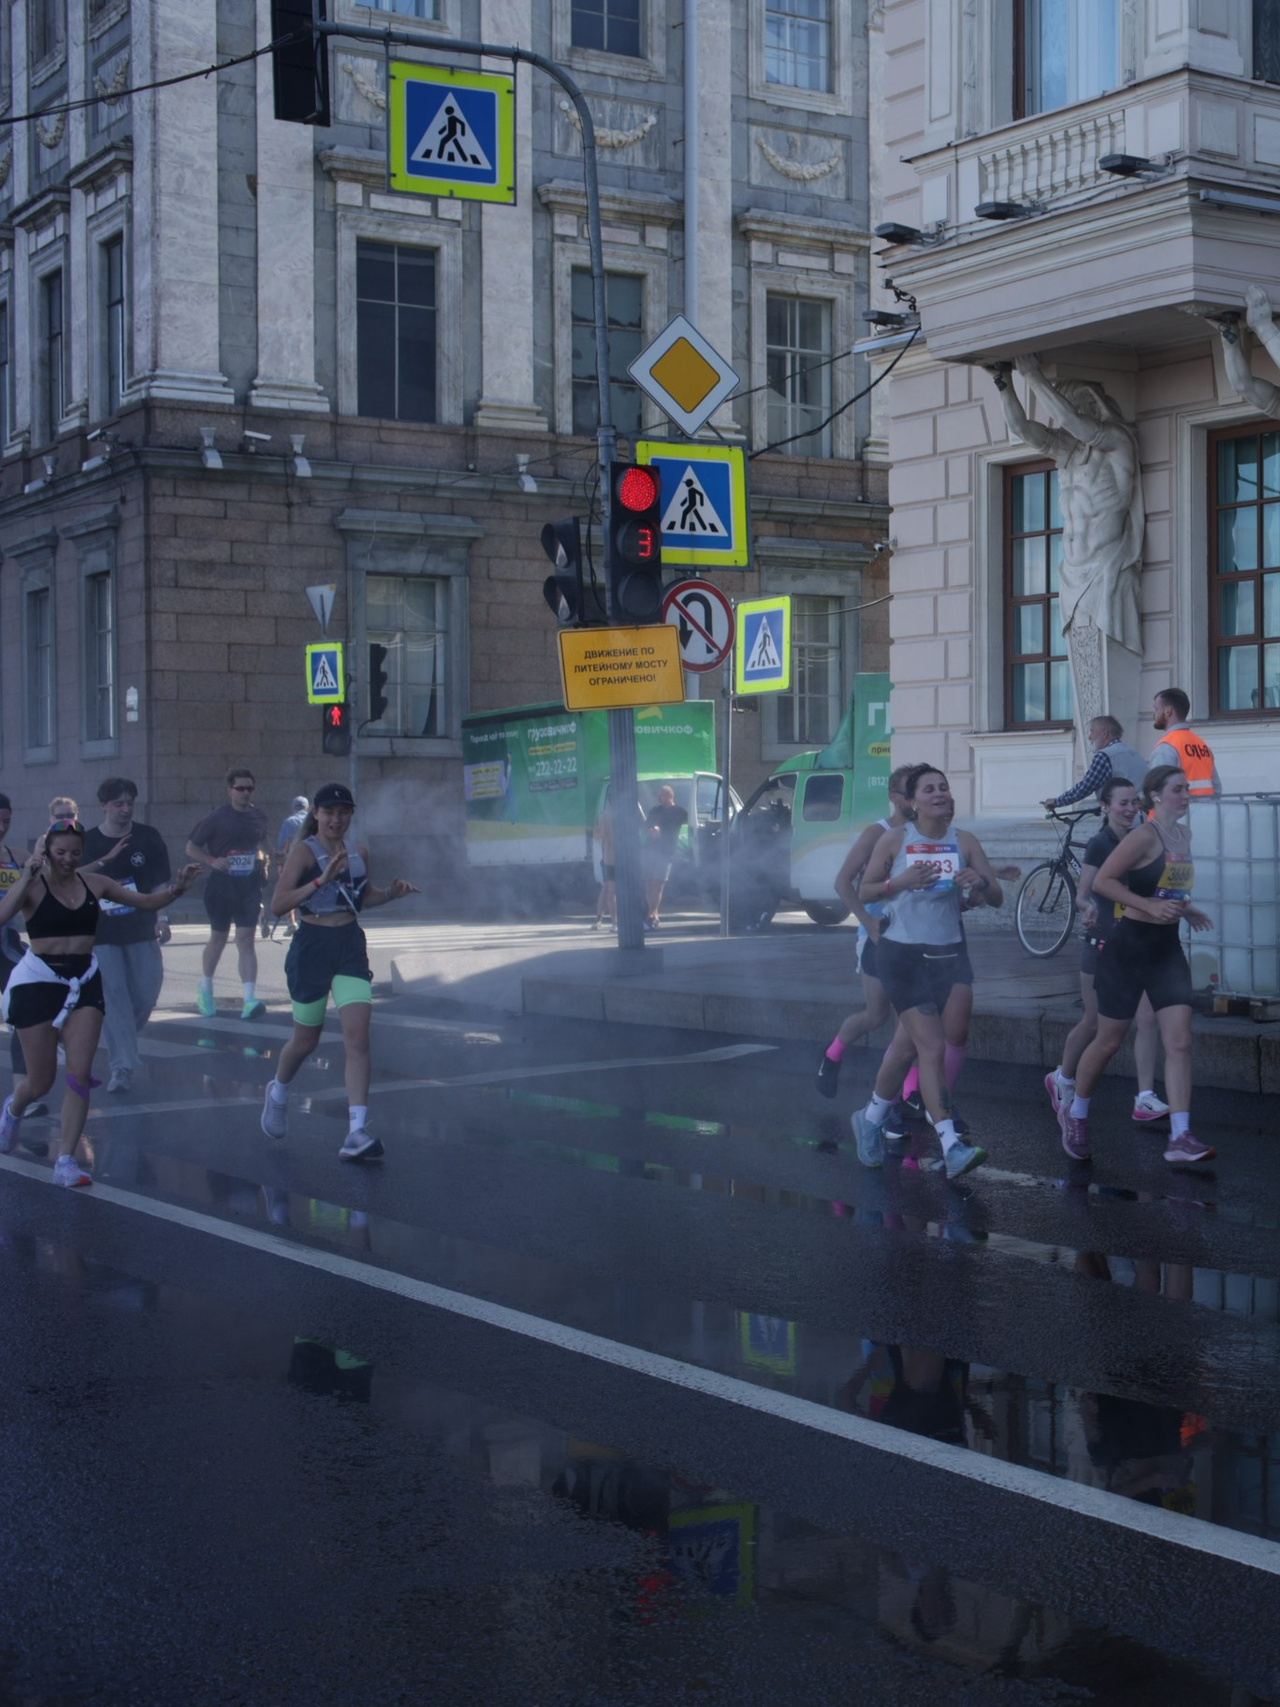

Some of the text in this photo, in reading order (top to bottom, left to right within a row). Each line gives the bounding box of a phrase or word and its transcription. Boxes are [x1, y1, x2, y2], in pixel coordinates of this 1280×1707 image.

[638, 528, 653, 557] 3
[584, 647, 655, 660] ДВИЖЕНИЕ ПО
[574, 660, 668, 673] ЛИТЕЙНОМУ МОСТУ
[588, 675, 656, 686] ОГРАНИЧЕНО!
